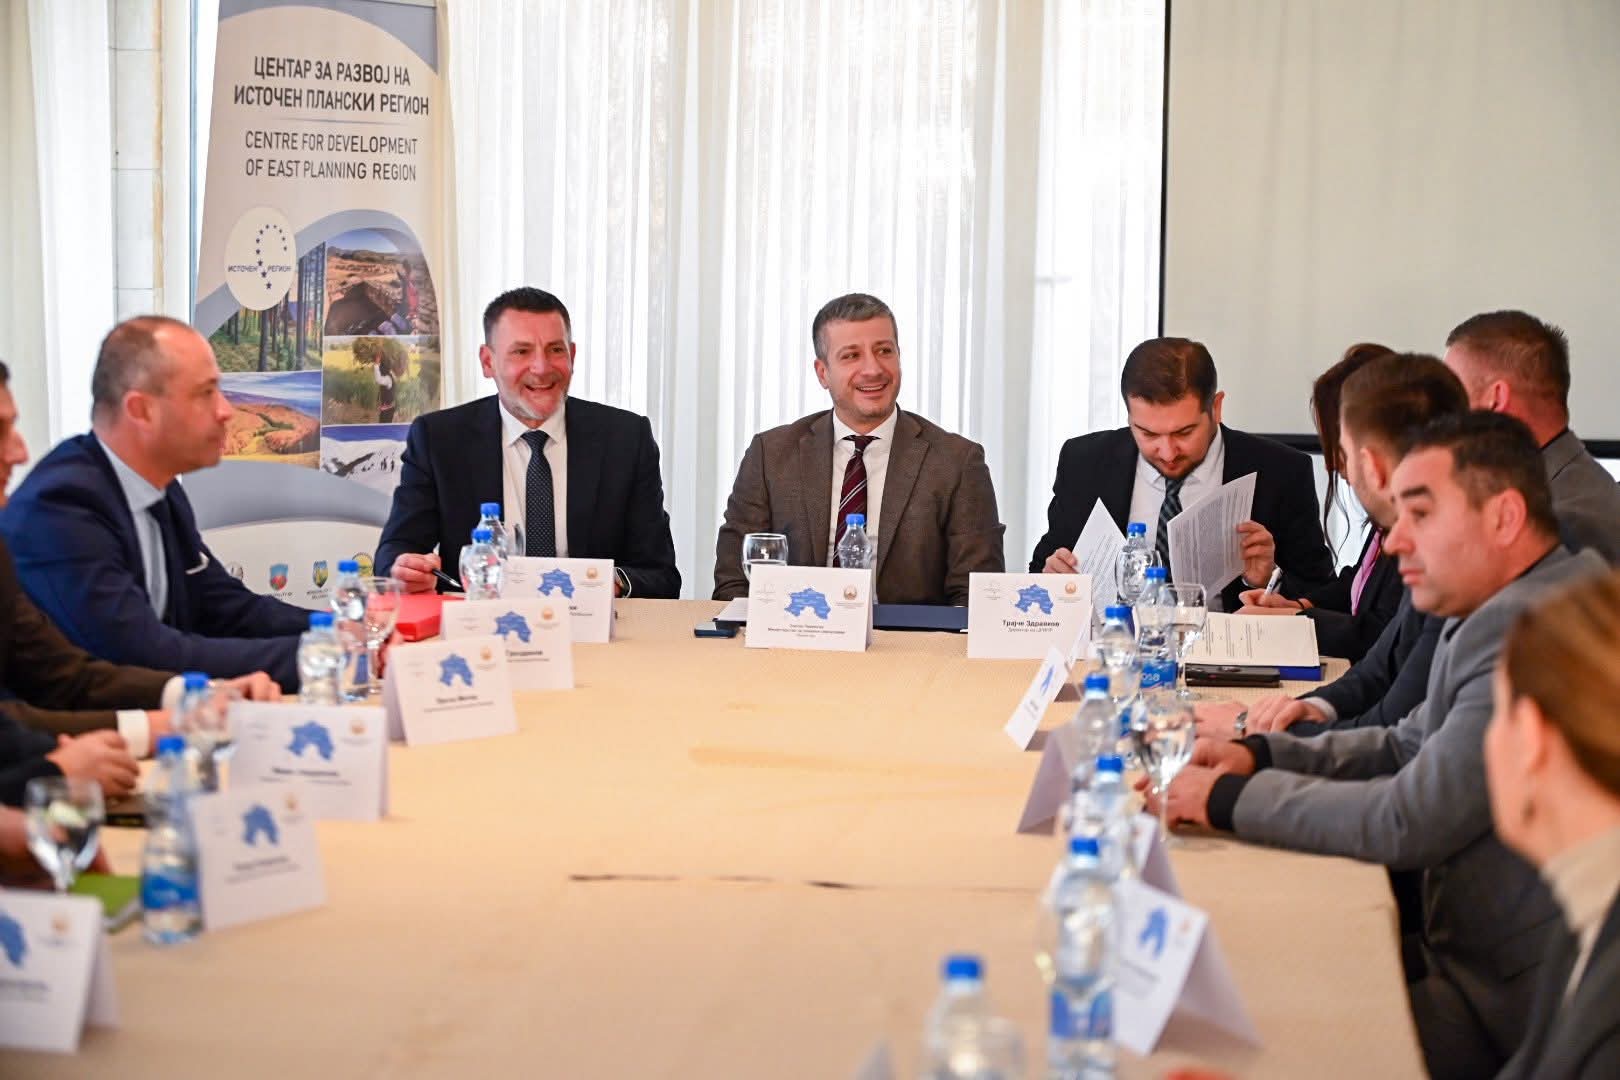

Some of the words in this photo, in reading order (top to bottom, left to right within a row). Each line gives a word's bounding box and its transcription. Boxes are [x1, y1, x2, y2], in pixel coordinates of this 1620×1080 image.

[254, 56, 312, 79] ЦЕНТАР
[315, 61, 332, 80] ЗА
[337, 62, 390, 84] РАЗВОЈ
[395, 66, 411, 86] НА
[234, 85, 303, 108] ИСТОЧЕН
[306, 89, 375, 112] ПЛАНСКИ
[380, 93, 429, 115] РЕГИОН
[245, 130, 299, 150] CENTRE
[302, 133, 324, 151] FOR
[328, 134, 418, 155] DEVELOPMENT
[246, 159, 263, 176] OF
[267, 159, 300, 177] EAST
[303, 161, 367, 180] PLANNING
[373, 162, 417, 181] REGION
